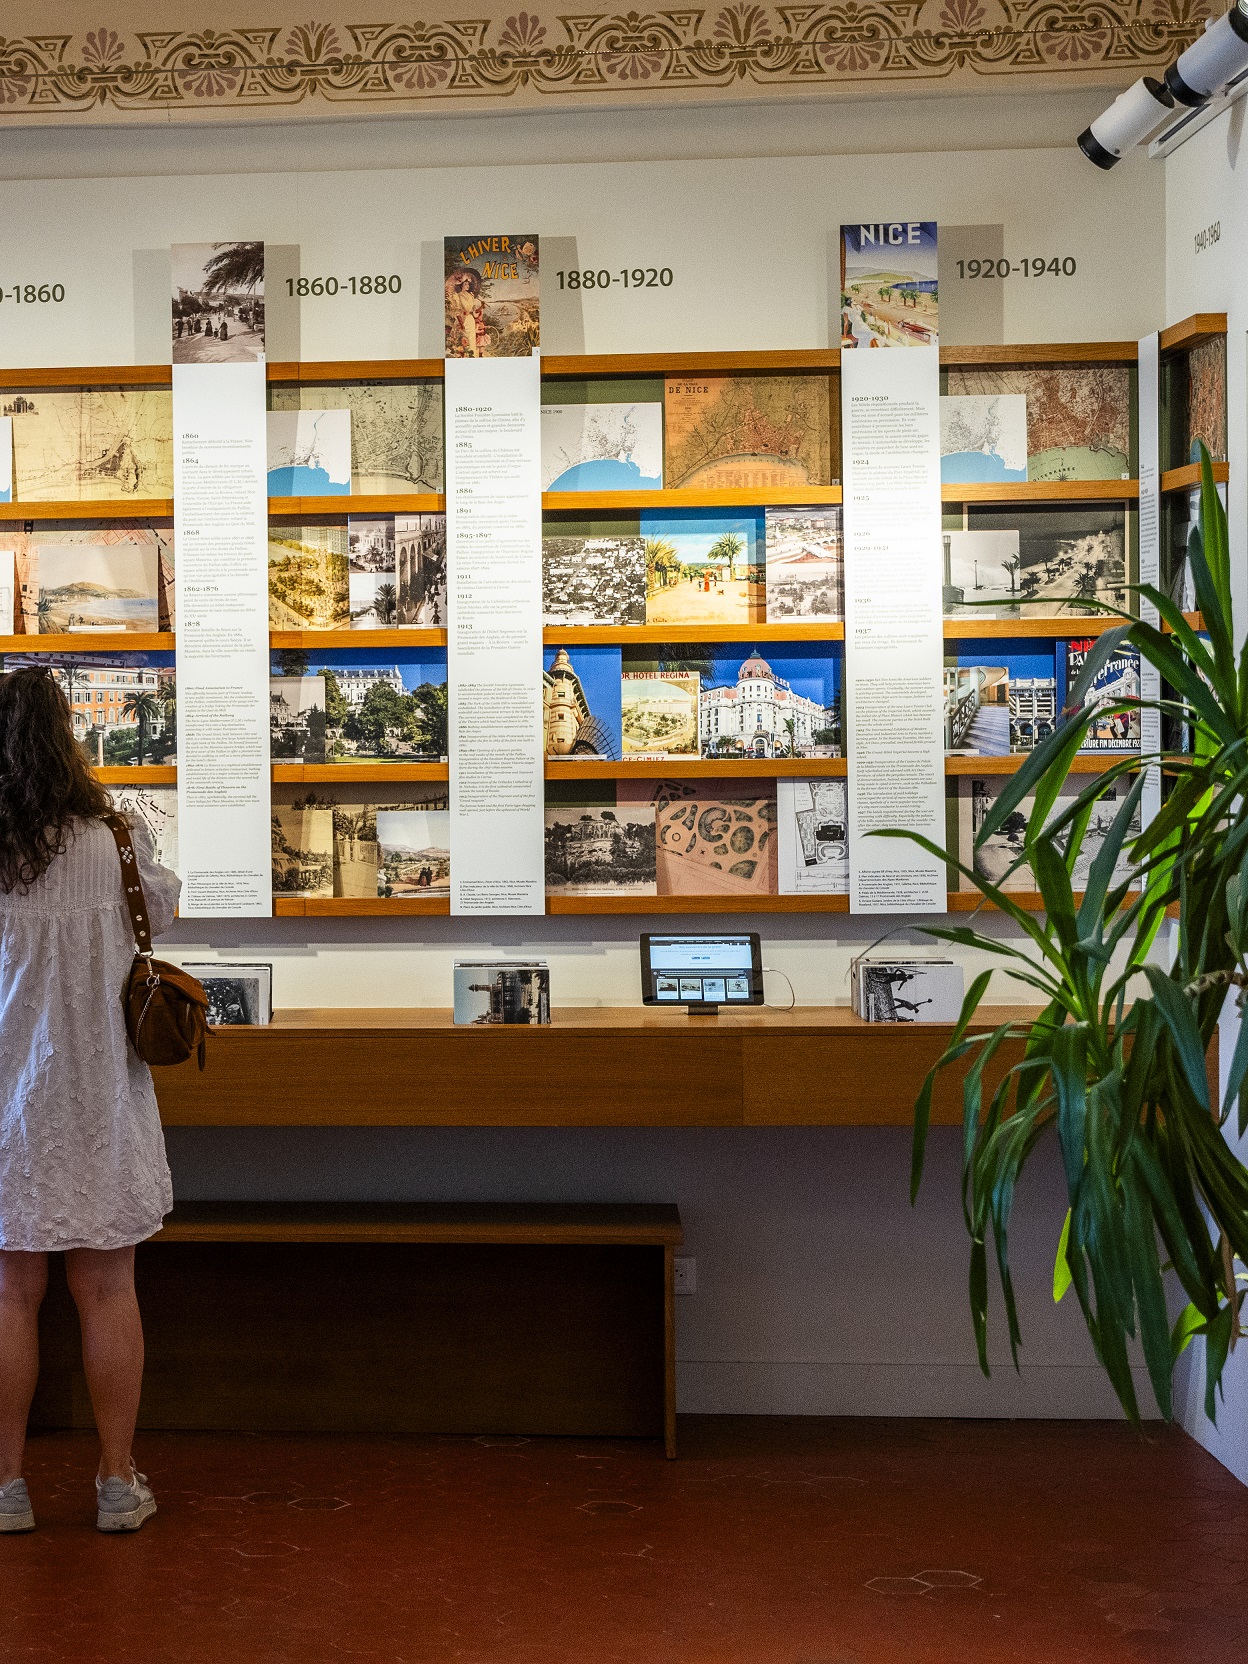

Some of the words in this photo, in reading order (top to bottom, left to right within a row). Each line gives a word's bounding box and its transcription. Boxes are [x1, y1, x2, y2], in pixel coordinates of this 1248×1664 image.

[860, 222, 921, 246] NICE
[1194, 220, 1221, 254] 1940-1960
[459, 236, 511, 265] L'HIVER
[481, 260, 520, 280] NICE
[557, 268, 674, 290] 1880-1920
[956, 256, 1077, 279] 1920-1940
[285, 275, 403, 298] 1860-1880
